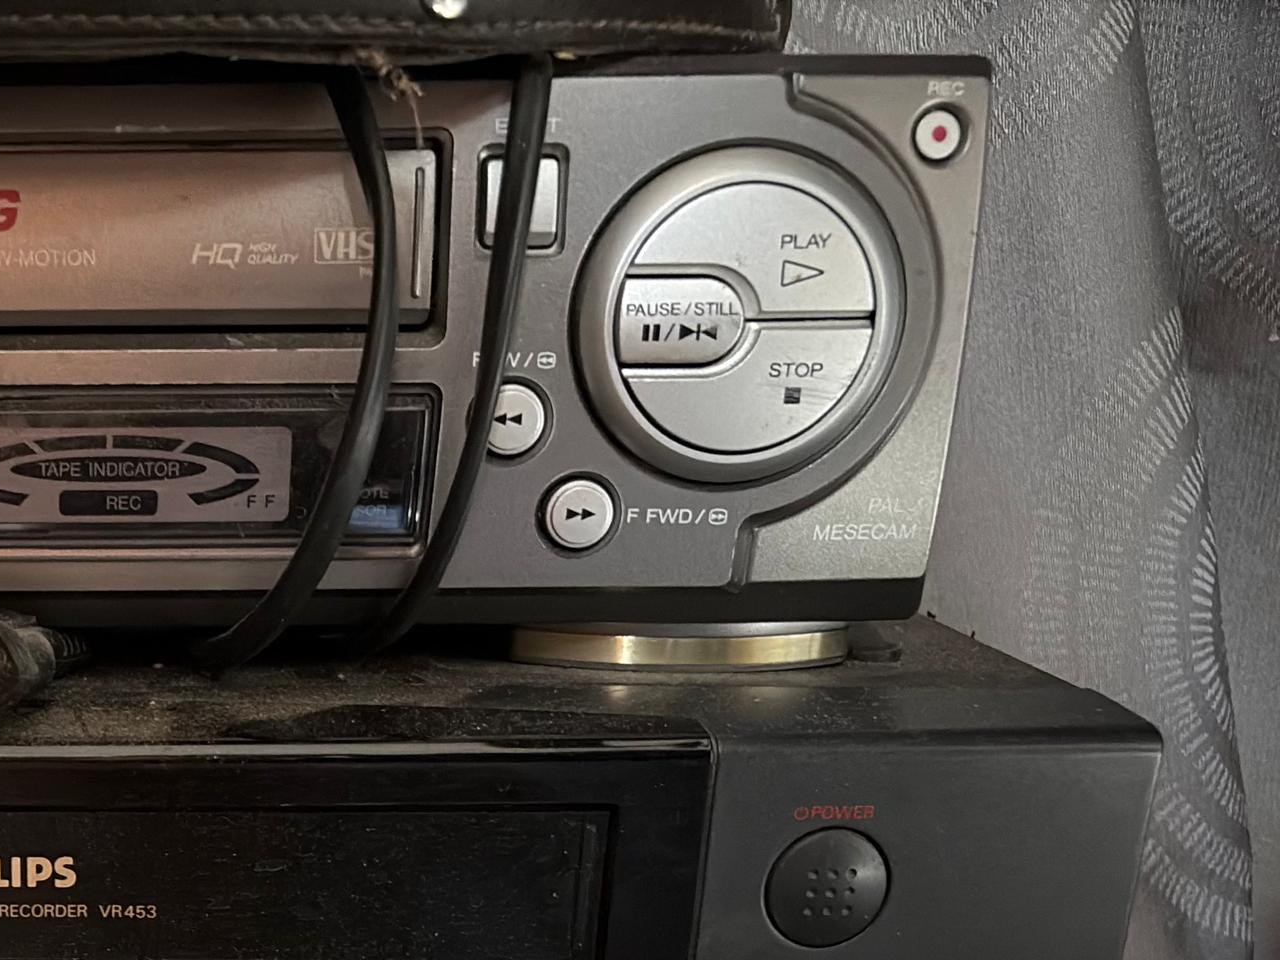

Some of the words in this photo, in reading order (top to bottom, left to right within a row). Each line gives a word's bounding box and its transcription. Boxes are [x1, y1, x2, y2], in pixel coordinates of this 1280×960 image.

[927, 80, 965, 96] REC
[780, 233, 832, 250] PLAY
[190, 242, 244, 270] HQ
[247, 254, 300, 266] QUALITY
[768, 363, 825, 378] STOP
[39, 461, 81, 478] TAPE
[88, 460, 181, 478] INDICATOR
[105, 495, 142, 511] REC
[813, 524, 918, 541] MESECAM
[810, 804, 876, 820] POWER
[99, 905, 157, 919] VR453
